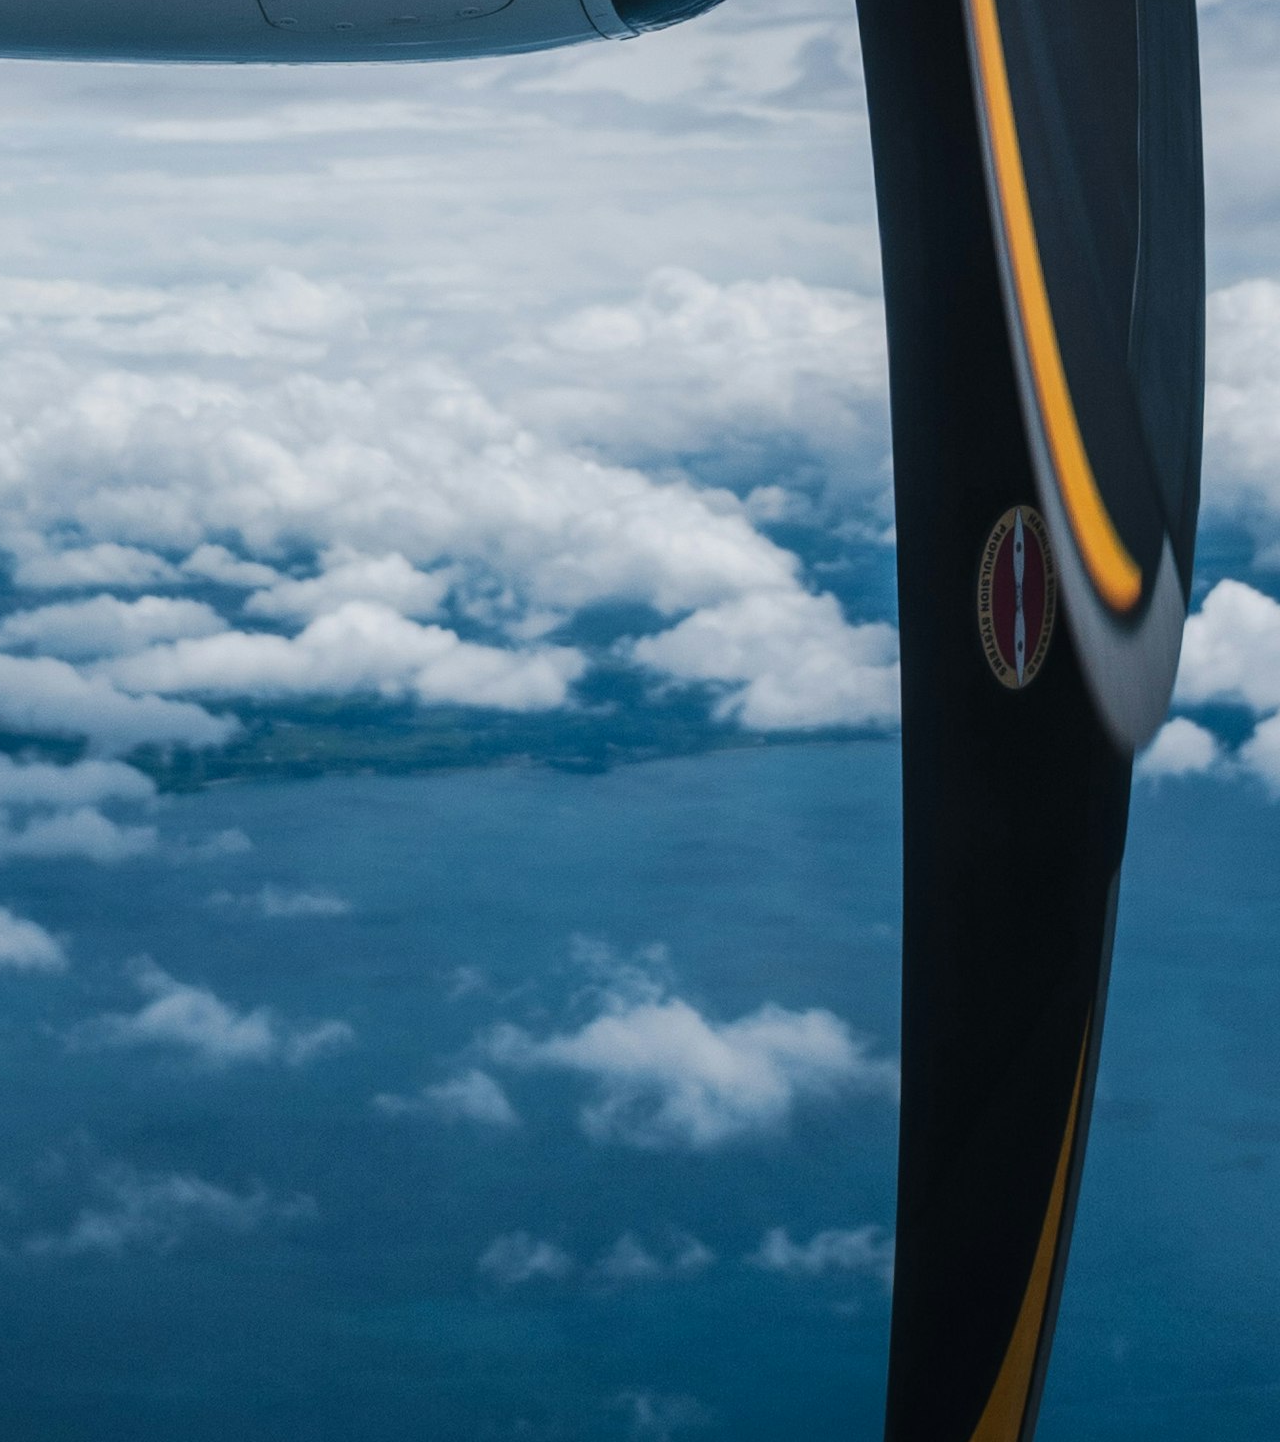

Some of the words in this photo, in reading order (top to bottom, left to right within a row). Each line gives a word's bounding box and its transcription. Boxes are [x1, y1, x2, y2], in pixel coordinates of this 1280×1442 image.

[980, 524, 1007, 613] PROPULSION
[1028, 515, 1054, 574] HAMILTON
[981, 617, 1007, 677] SYSTEMS
[1027, 577, 1055, 676] SUNDSTRAND
